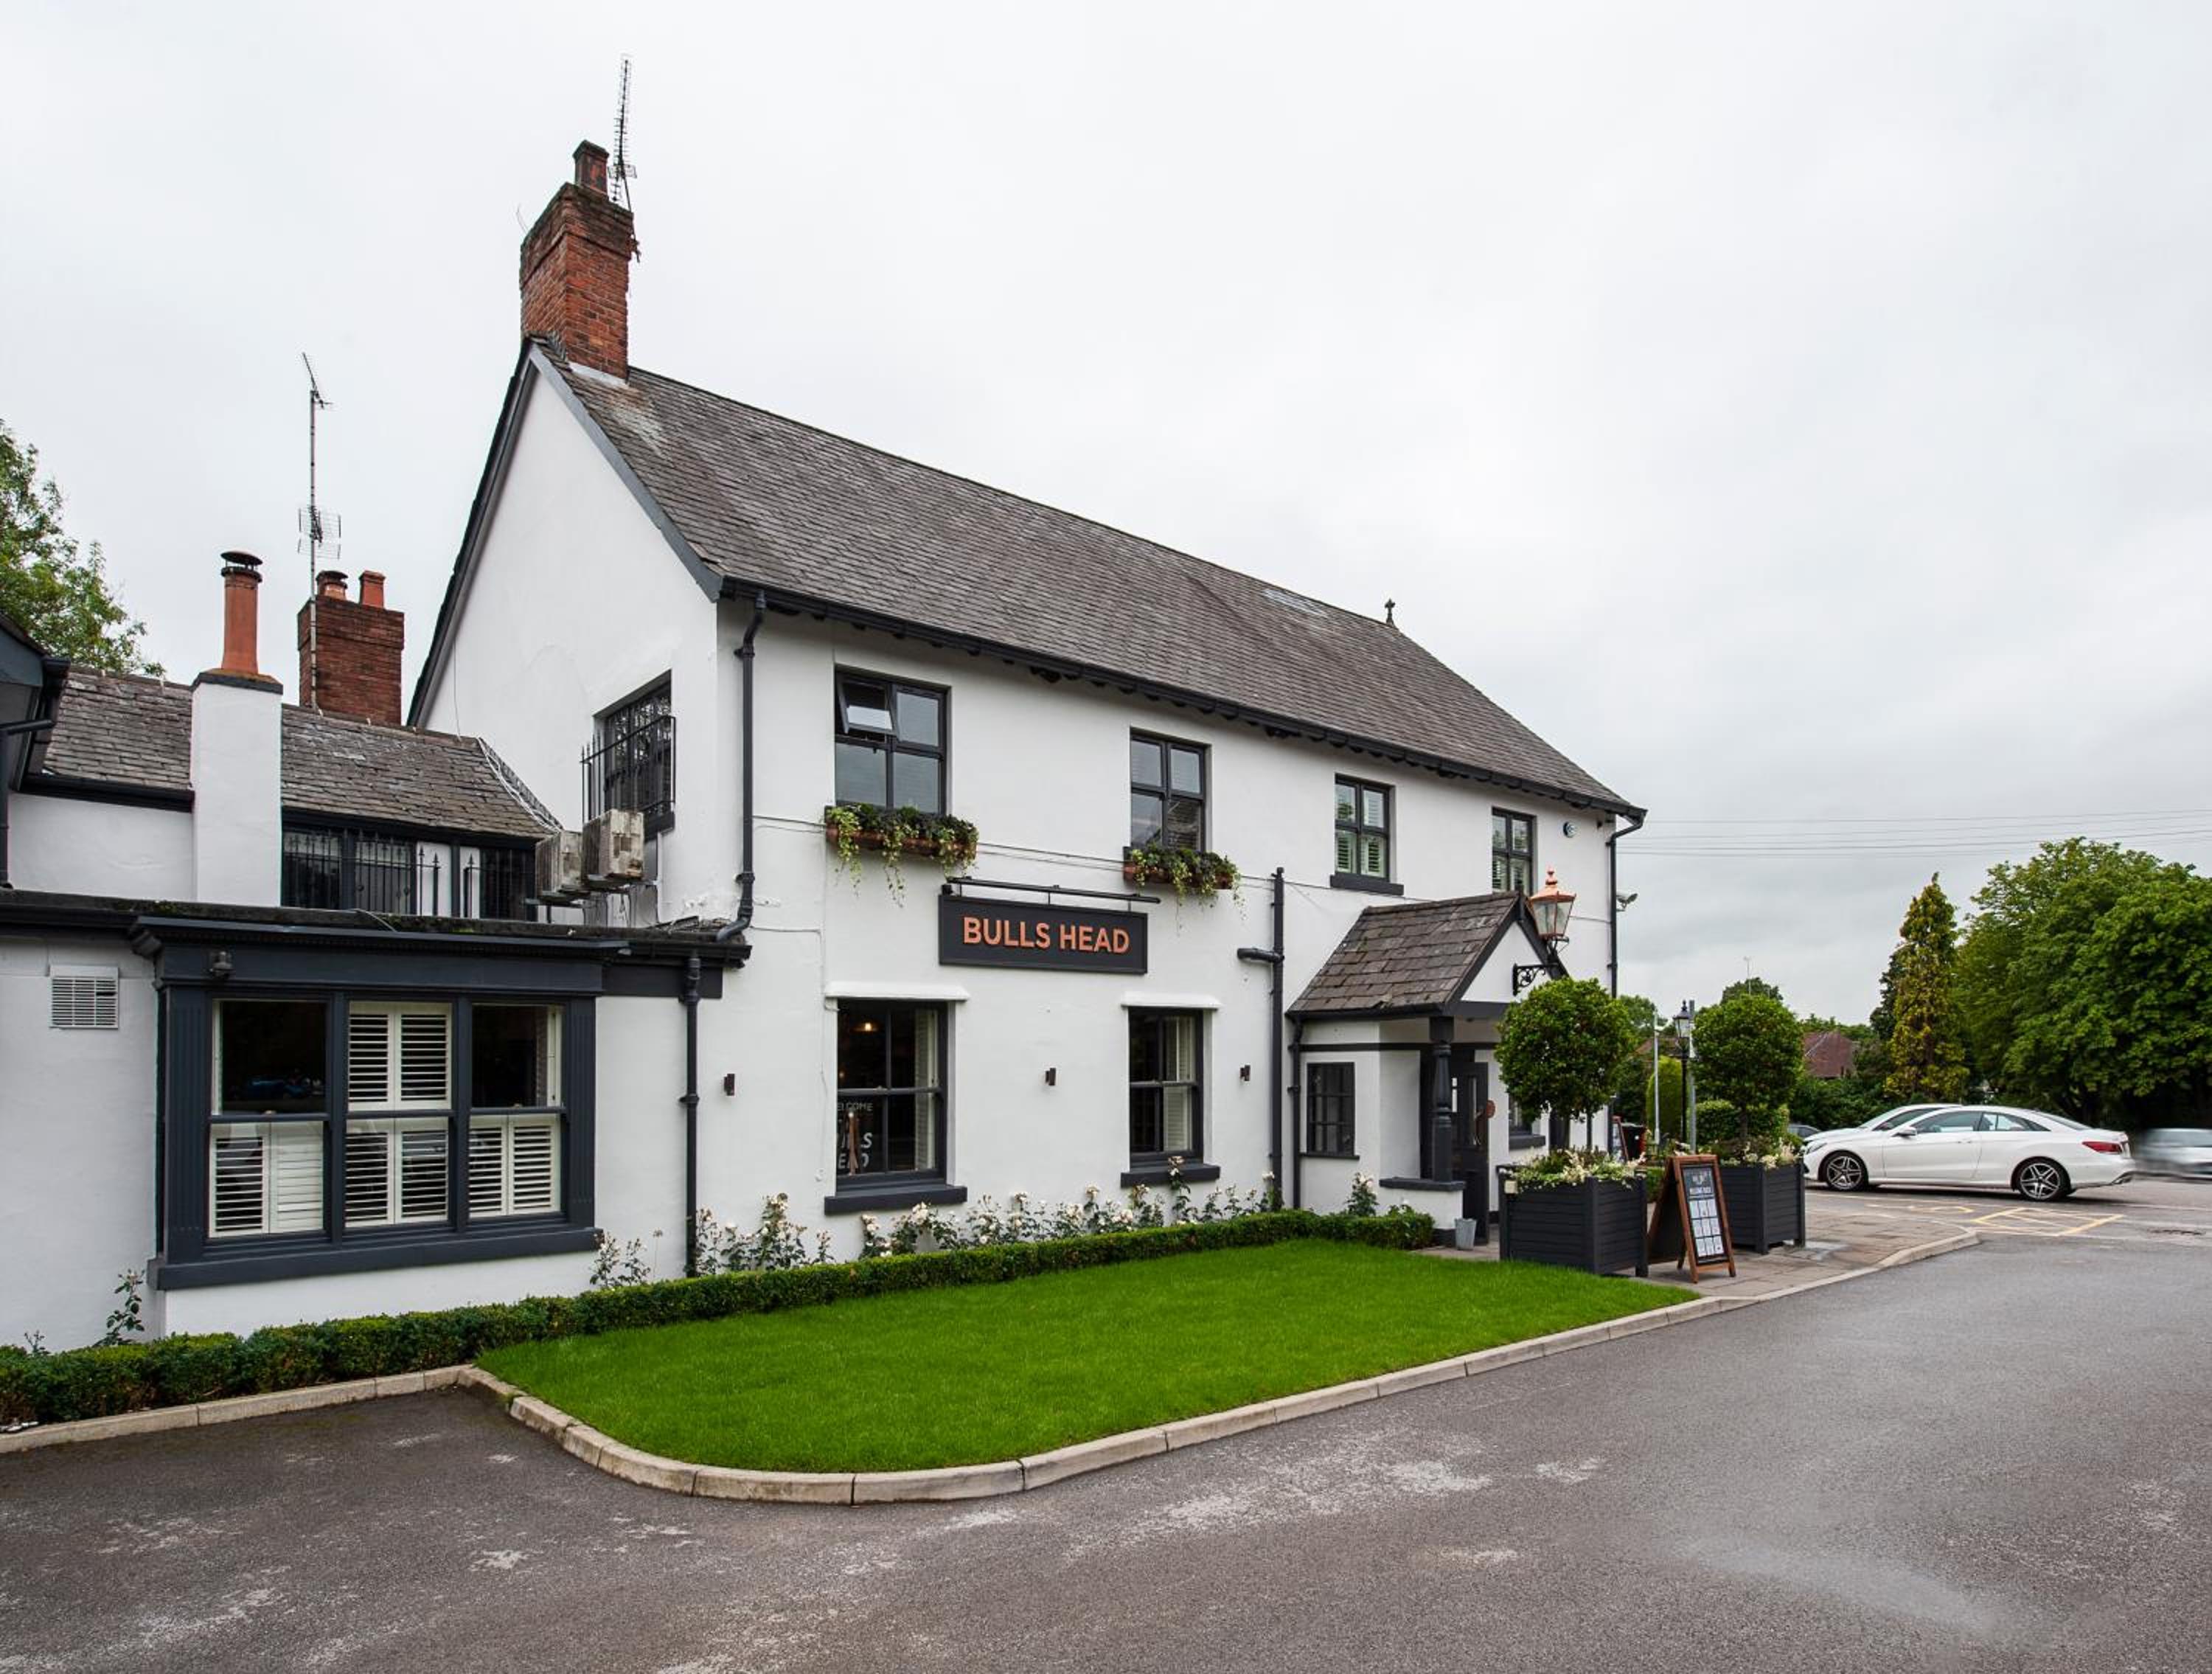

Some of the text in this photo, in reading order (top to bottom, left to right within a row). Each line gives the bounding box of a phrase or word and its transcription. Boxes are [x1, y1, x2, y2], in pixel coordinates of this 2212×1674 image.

[963, 916, 1130, 954] BULLS HEAD
[838, 1102, 873, 1111] ELCOME
